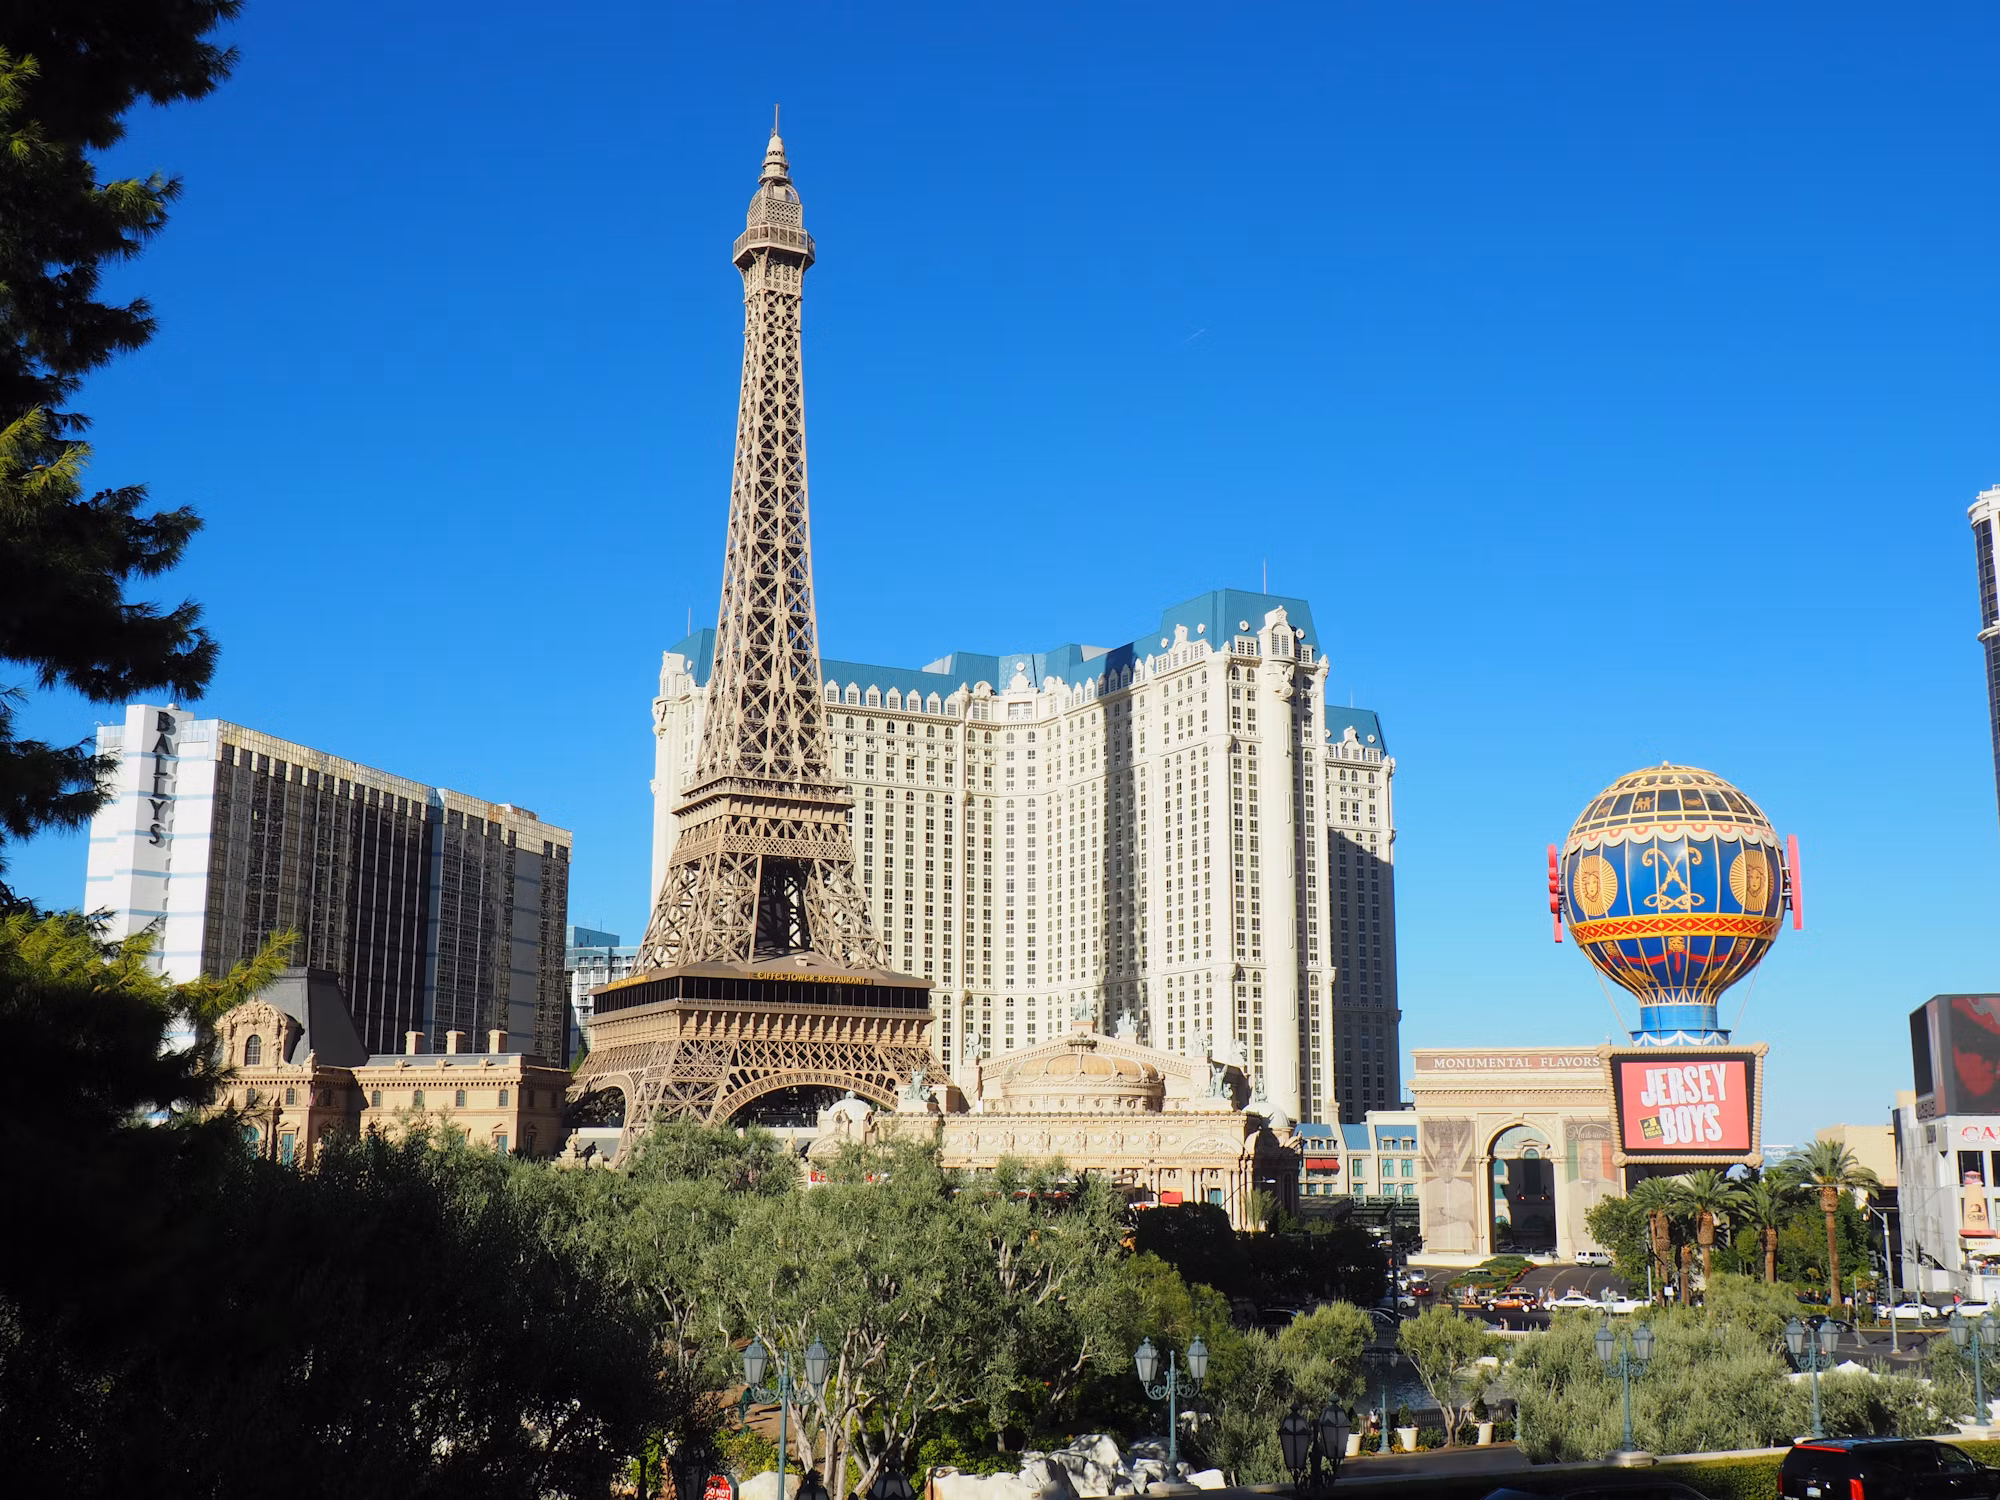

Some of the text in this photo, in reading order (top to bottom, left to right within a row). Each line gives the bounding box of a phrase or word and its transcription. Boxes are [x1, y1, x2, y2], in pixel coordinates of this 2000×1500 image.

[148, 711, 171, 845] BALLYS
[757, 971, 866, 985] EIFFEL TOWER RESTAURANT
[1434, 1056, 1600, 1069] MONUMENTAL FLAVORS
[1641, 1063, 1727, 1107] JERSEY
[1659, 1103, 1723, 1145] BOYS
[1961, 1126, 2000, 1142] CA
[716, 1489, 730, 1498] NOT
